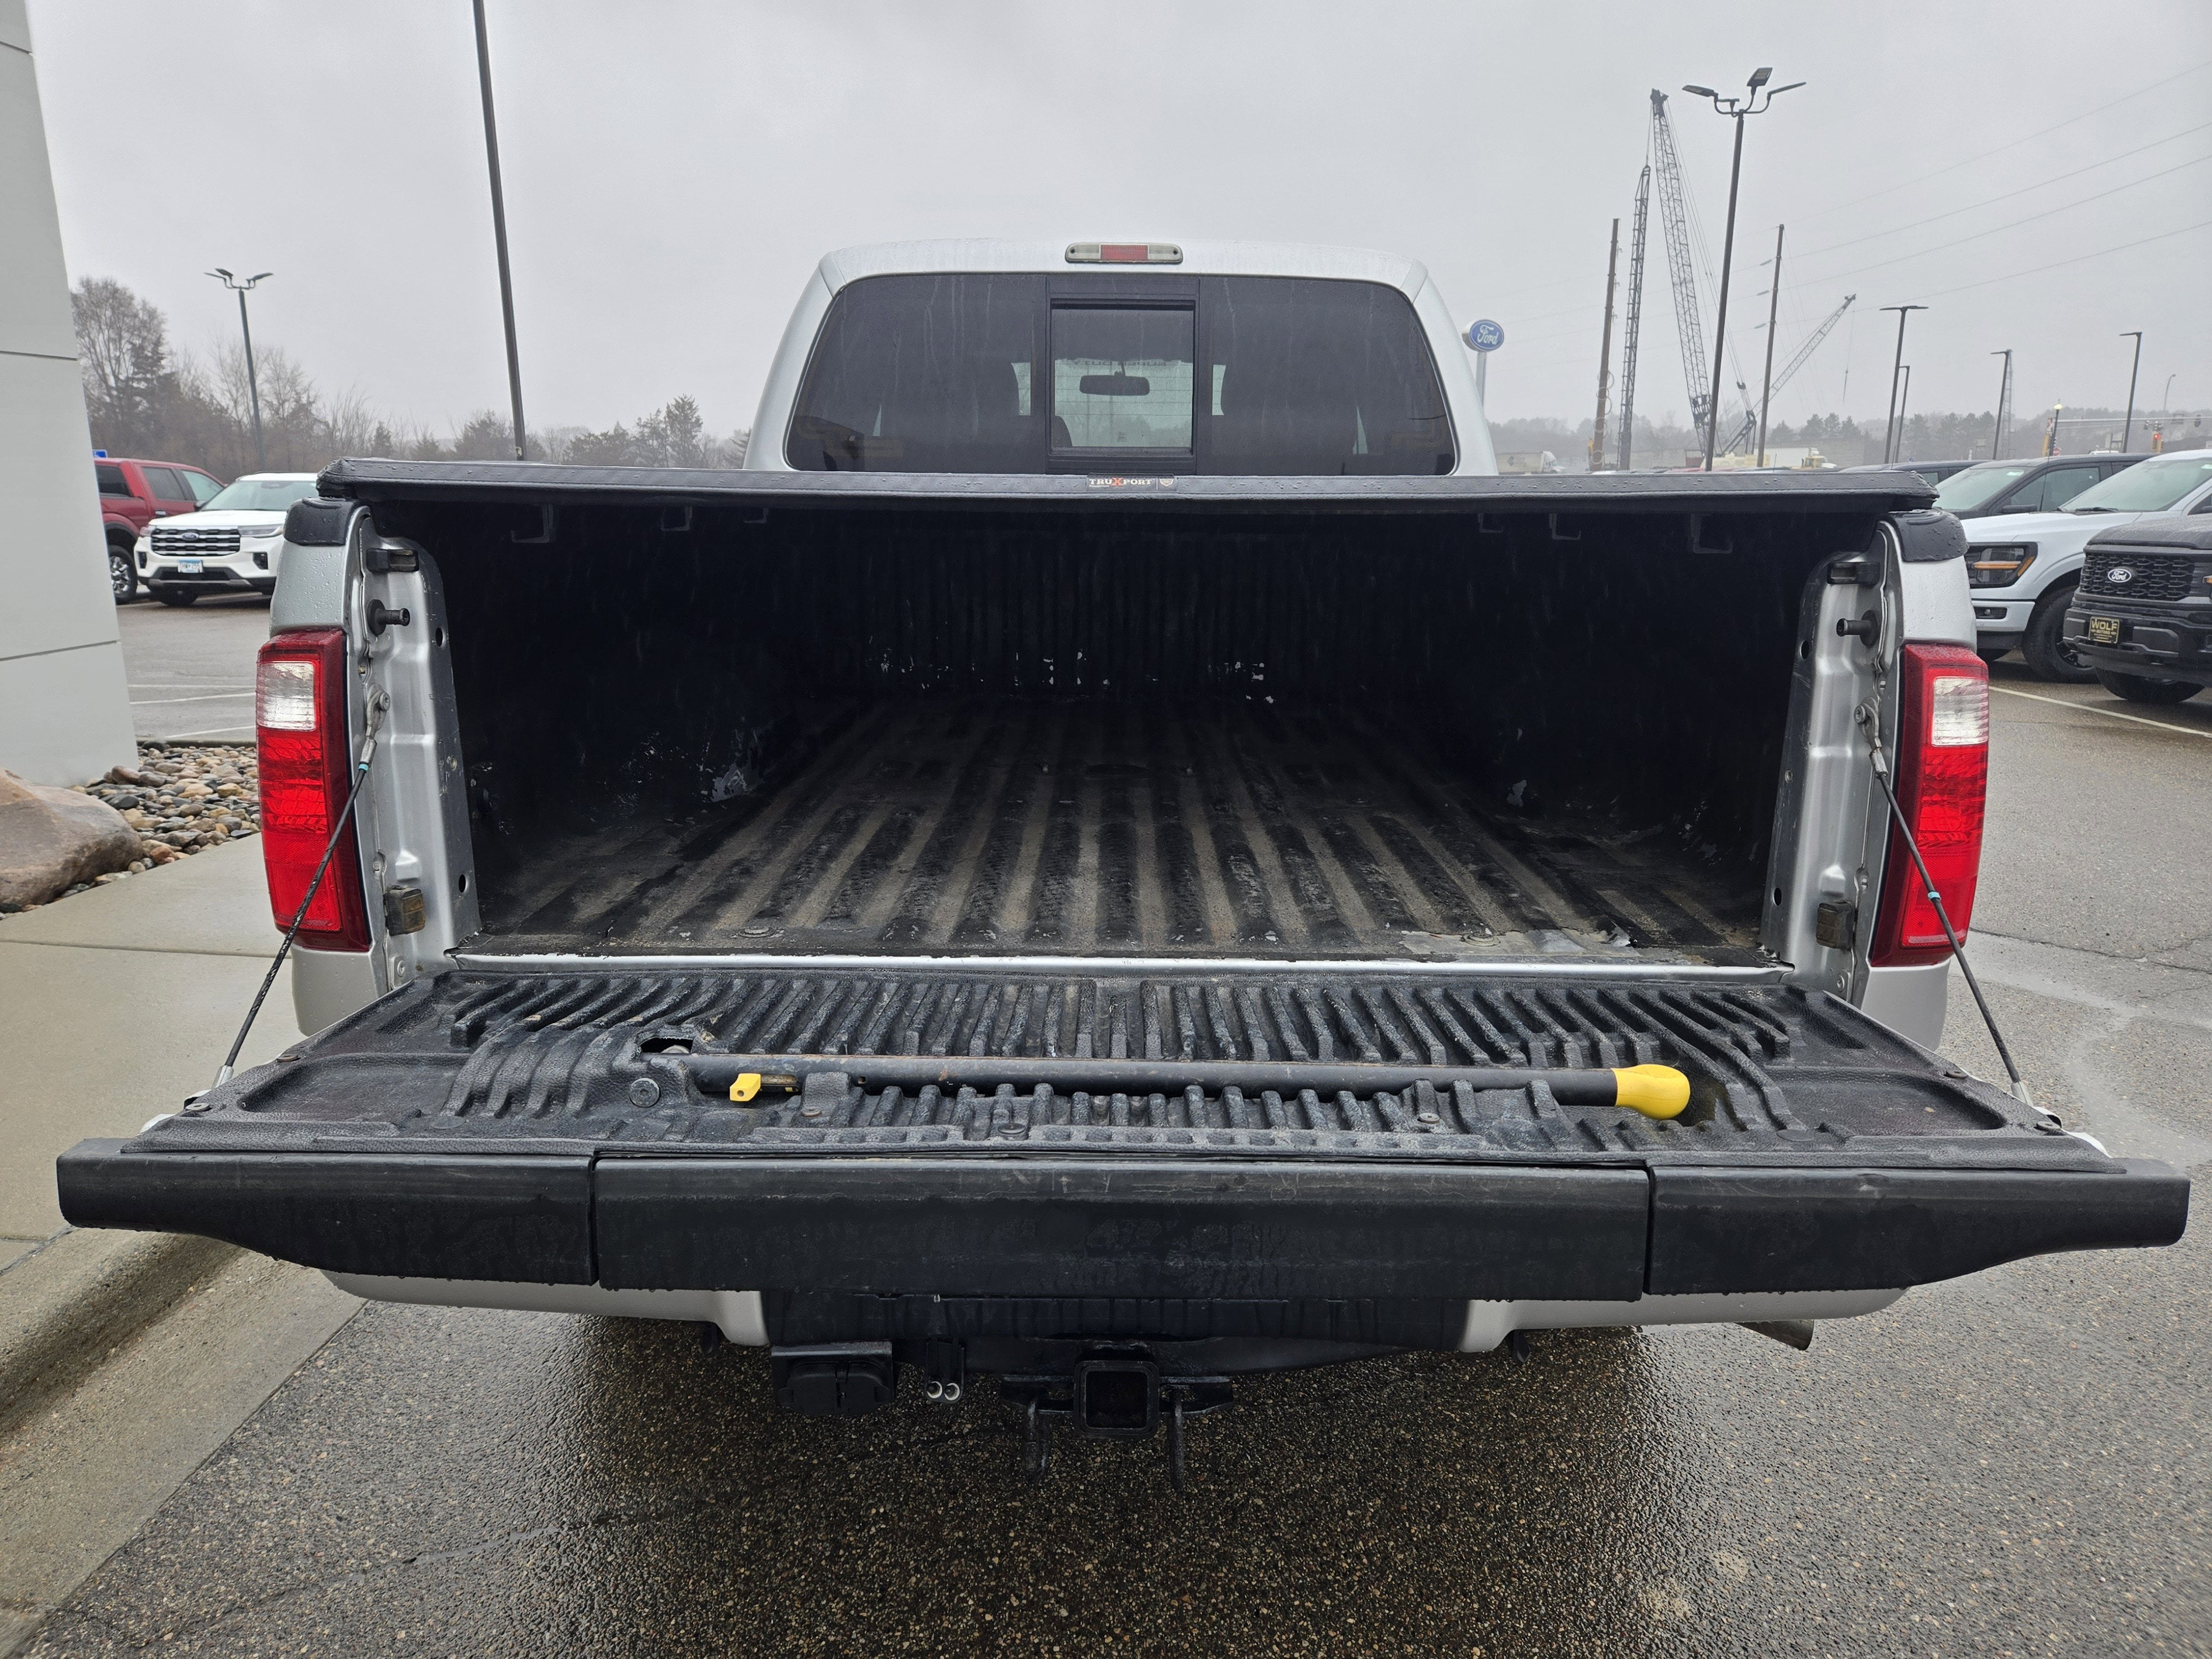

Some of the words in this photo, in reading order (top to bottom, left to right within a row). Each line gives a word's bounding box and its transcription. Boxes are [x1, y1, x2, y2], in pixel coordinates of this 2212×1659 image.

[1477, 325, 1499, 345] Ford
[1089, 477, 1152, 486] TRUXPORT
[2111, 570, 2127, 580] Ford
[2091, 620, 2117, 631] WOLF
